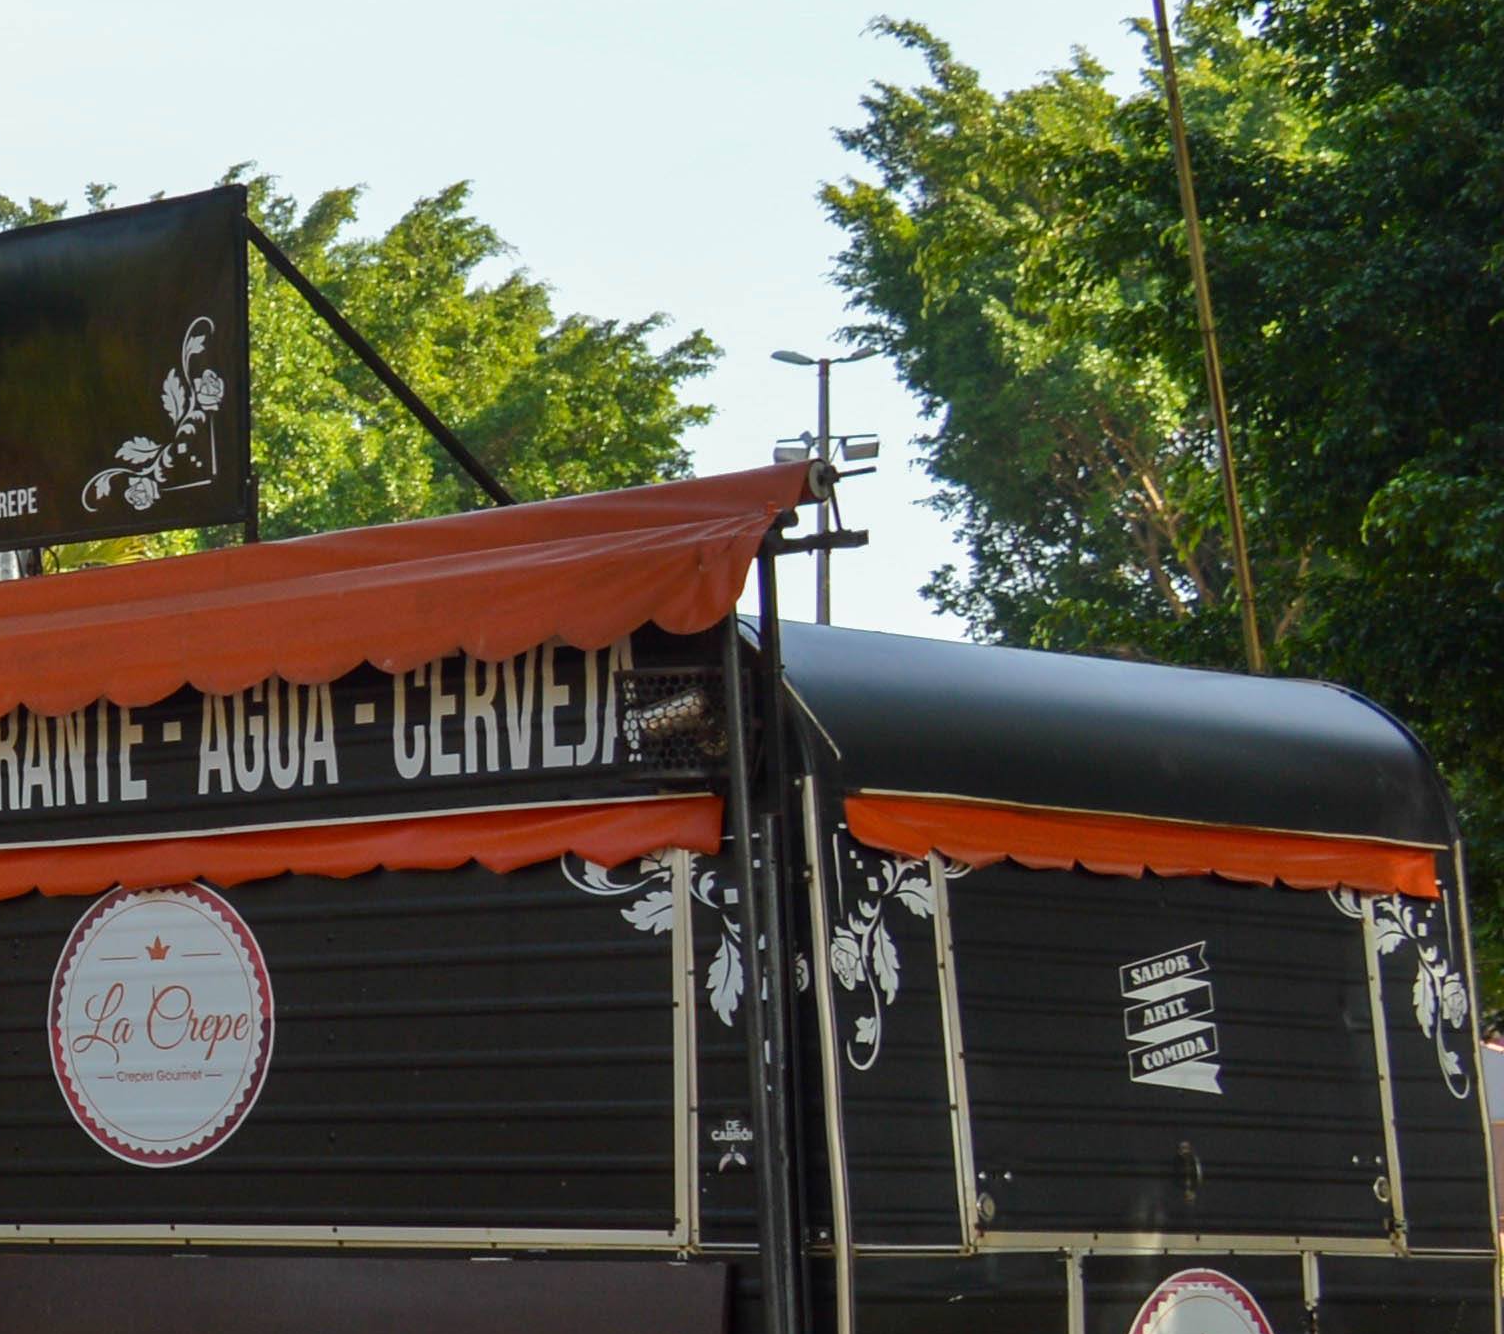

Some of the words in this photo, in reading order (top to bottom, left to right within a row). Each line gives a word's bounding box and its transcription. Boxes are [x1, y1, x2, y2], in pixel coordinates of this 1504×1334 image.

[1130, 954, 1191, 985] SABOR
[72, 982, 134, 1064] La
[146, 984, 250, 1061] Crepe
[1143, 997, 1190, 1026] ARTE
[1141, 1036, 1209, 1070] COMIDA
